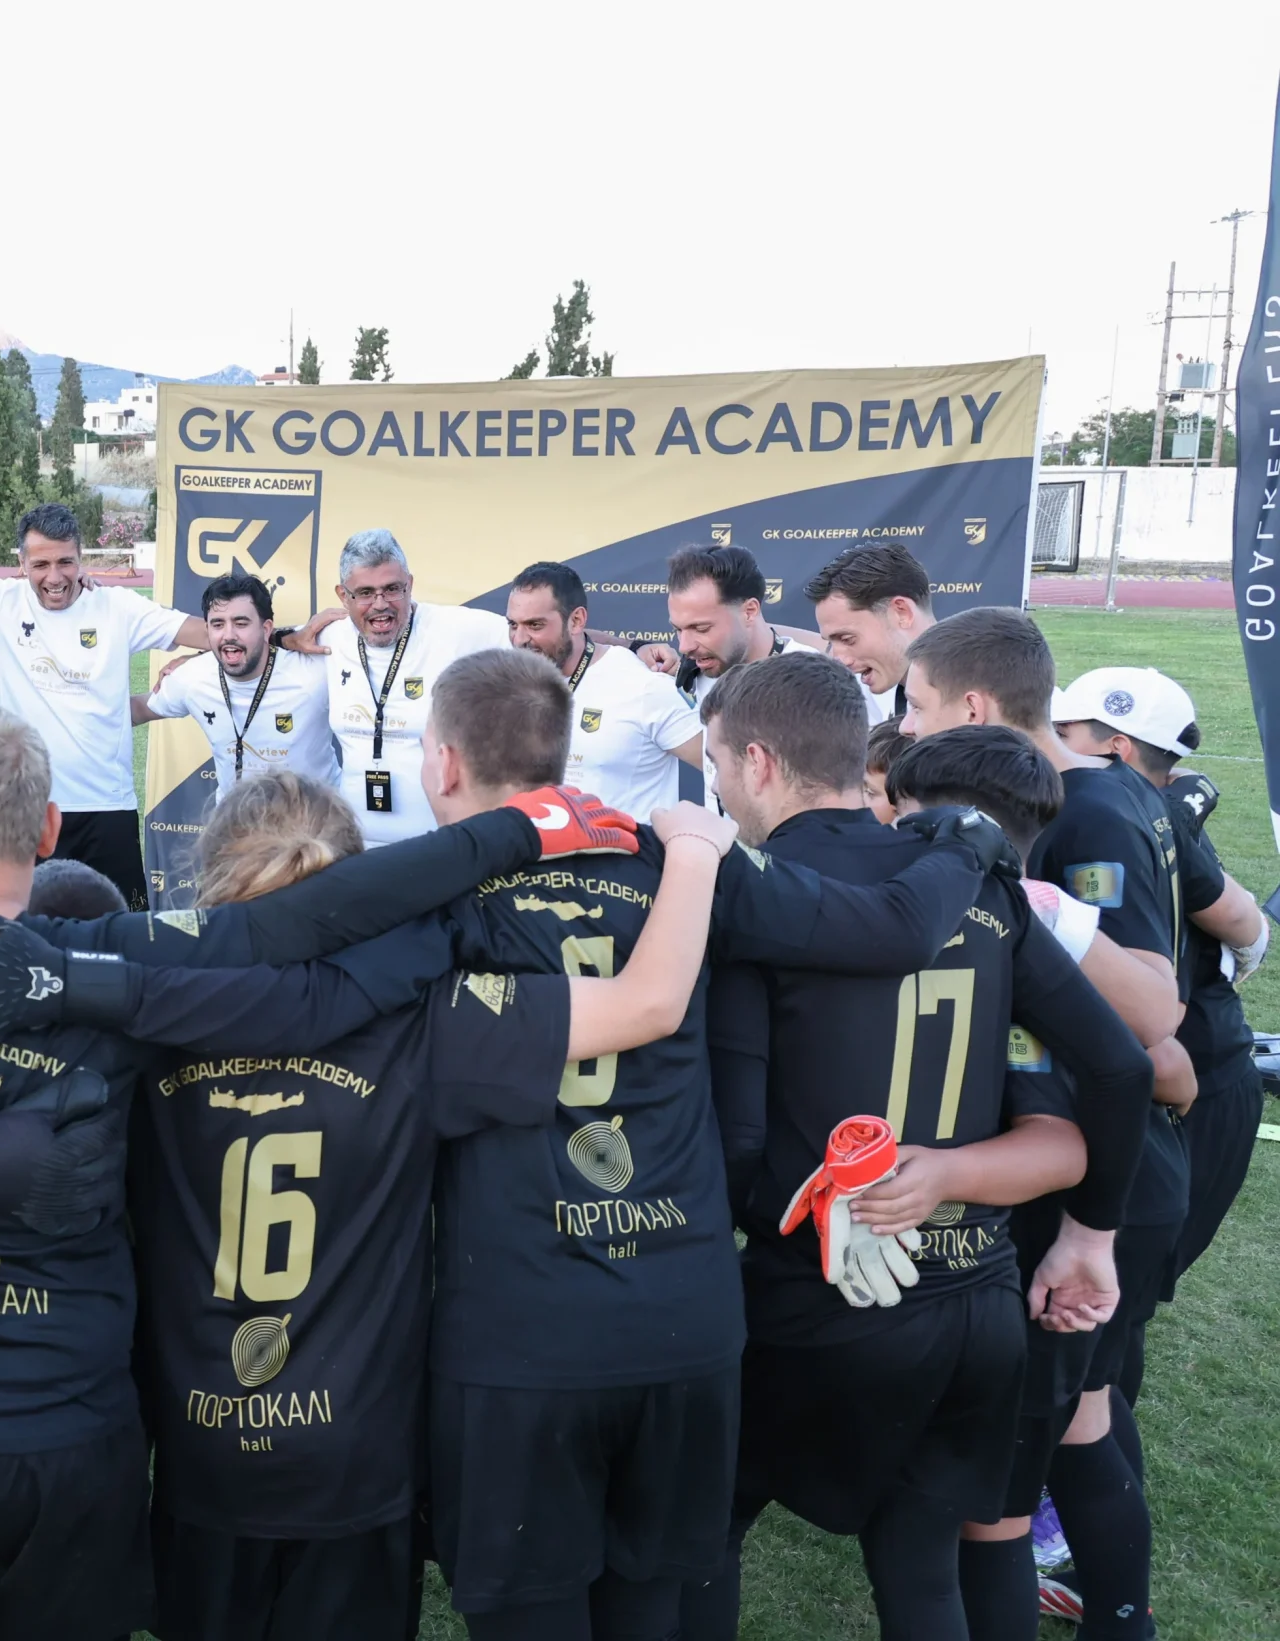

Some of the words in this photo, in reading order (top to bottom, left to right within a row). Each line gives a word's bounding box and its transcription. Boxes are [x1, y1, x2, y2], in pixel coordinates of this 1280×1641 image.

[178, 408, 255, 454] GK
[273, 408, 636, 457] GOALKEEPER
[655, 391, 1002, 456] ACADEMY
[182, 475, 251, 489] GOALKEEPER
[253, 478, 313, 491] ACADEMY
[763, 530, 780, 539] GK
[783, 528, 858, 539] GOALKEEPER
[862, 525, 926, 538] ACADEMY
[187, 517, 270, 579] GK
[583, 583, 598, 593] GK
[929, 582, 982, 593] CADEMY
[619, 631, 676, 641] ACADEMY
[384, 660, 398, 688] ACADEMY
[571, 654, 589, 683] ACADEMY
[384, 715, 407, 728] iew
[259, 748, 289, 756] view
[178, 879, 192, 889] GK
[964, 906, 1010, 939] ADEMY
[72, 951, 97, 960] WOLF
[98, 953, 119, 961] PRO
[886, 968, 975, 1142] 17
[285, 1058, 376, 1099] ACADEMY
[213, 1131, 323, 1302] 16
[608, 1242, 637, 1259] hall
[240, 1436, 273, 1452] hall
